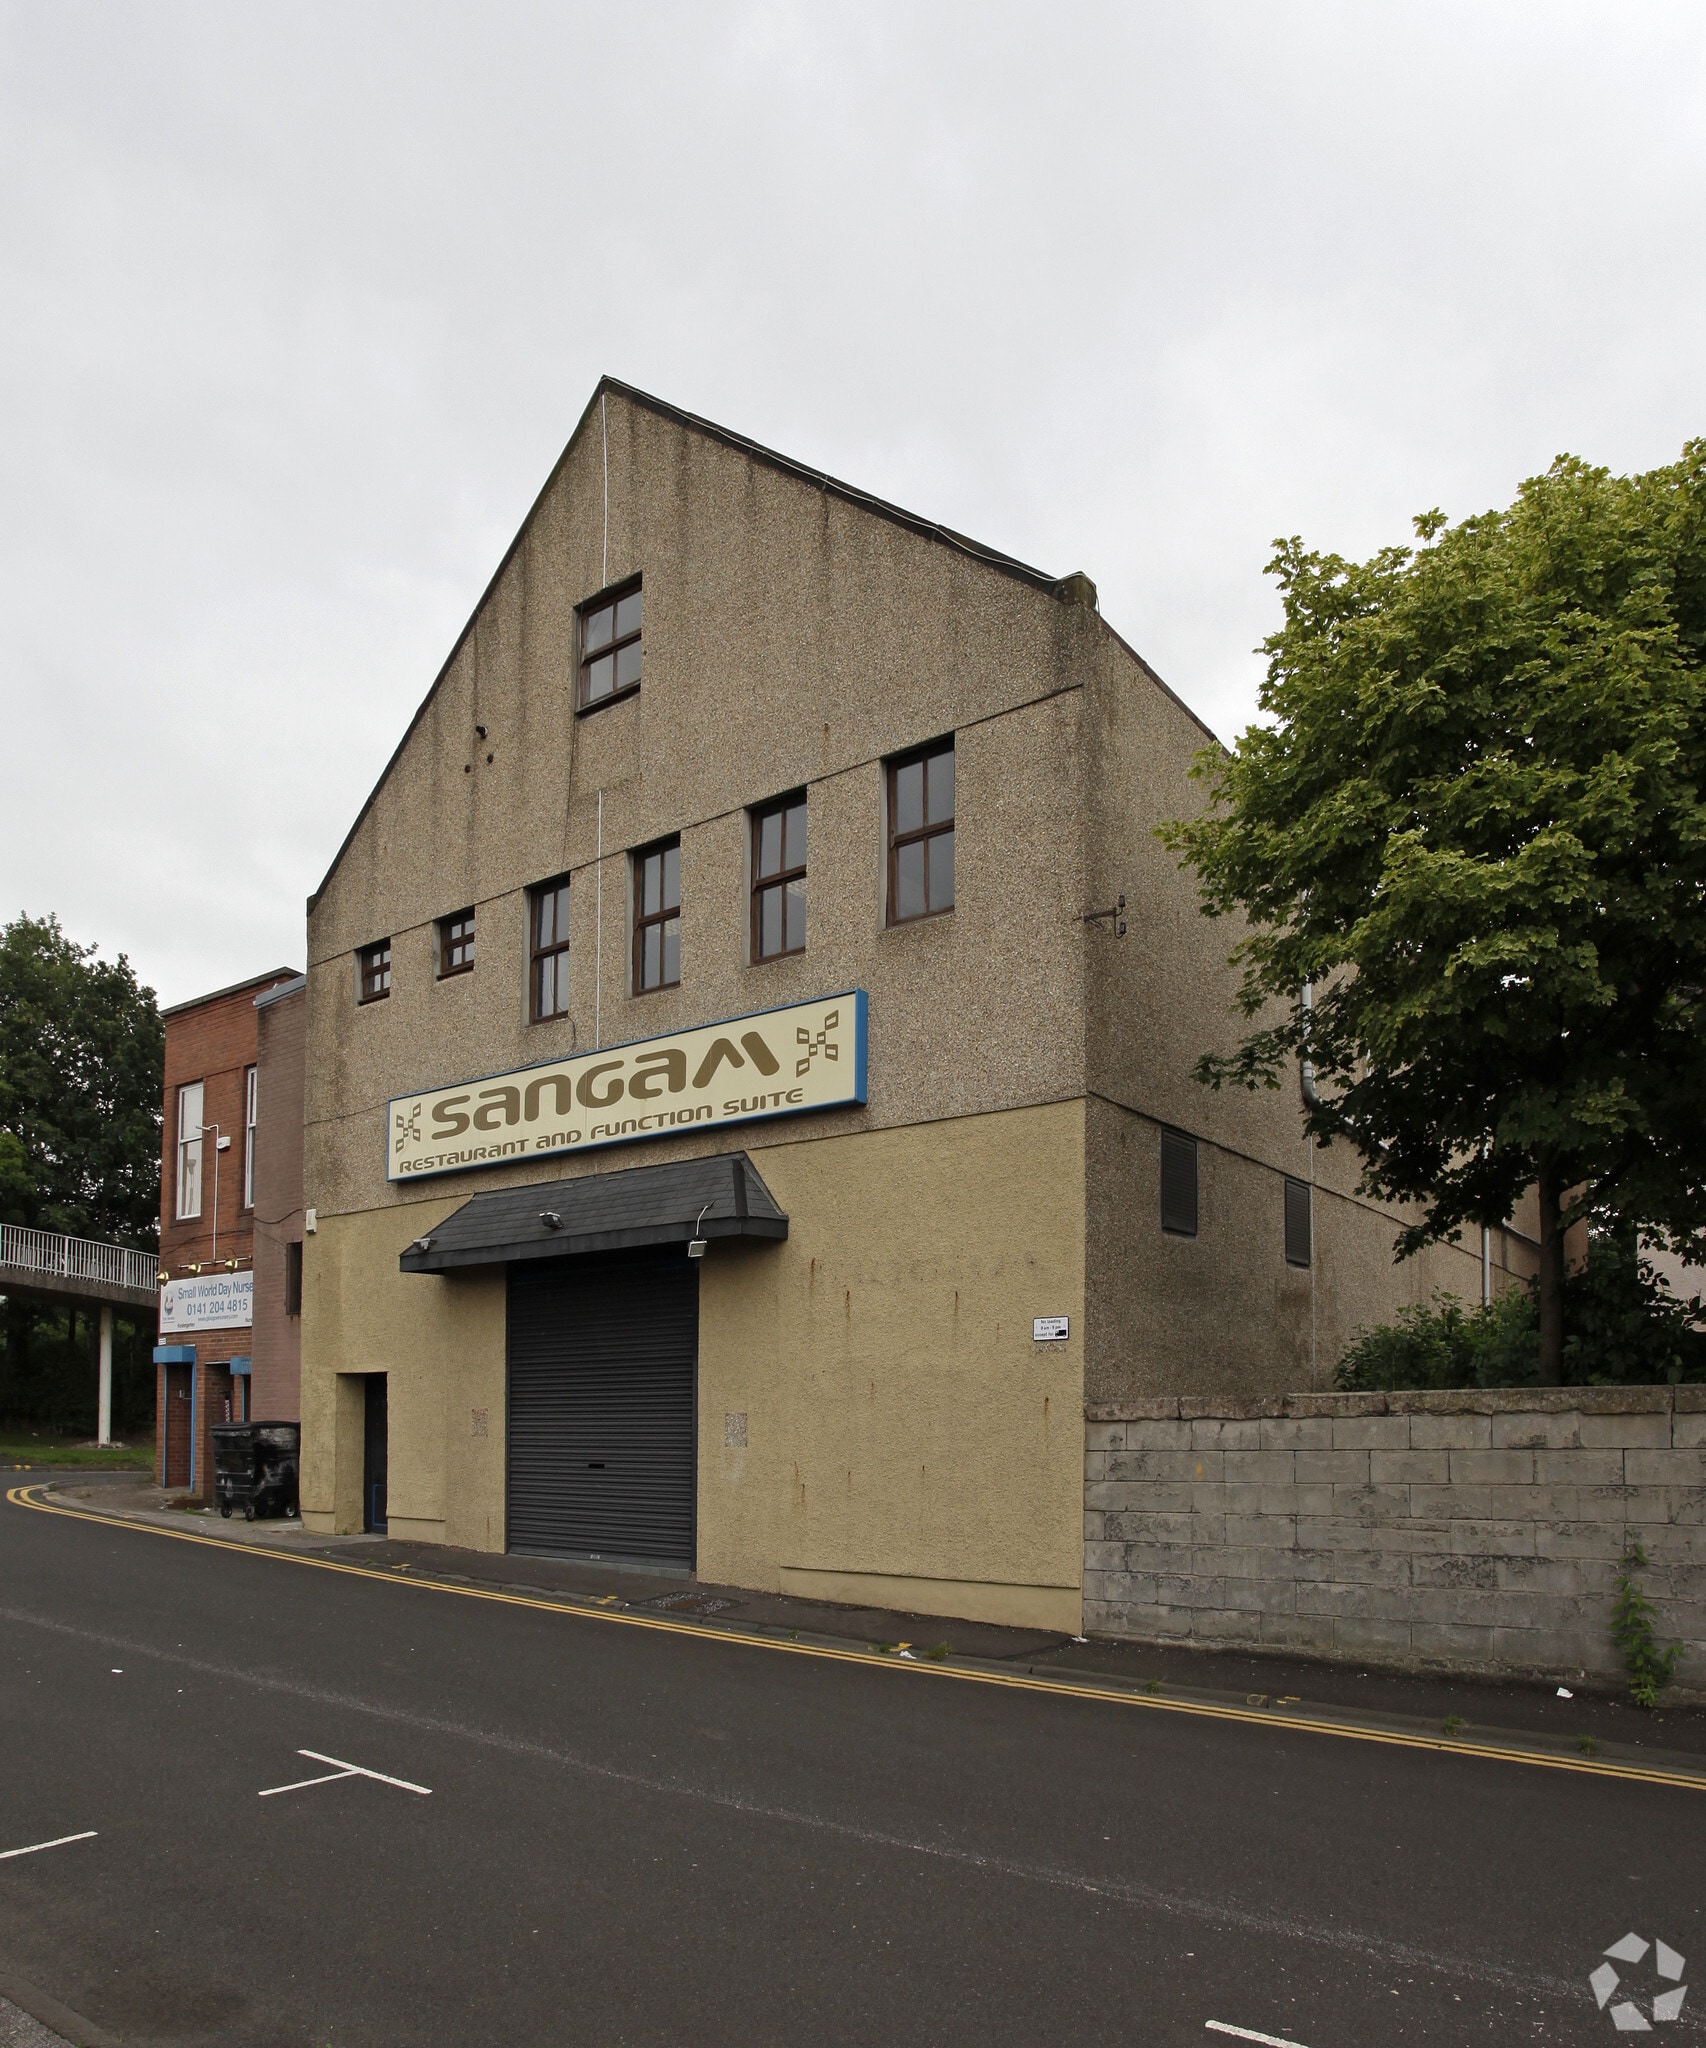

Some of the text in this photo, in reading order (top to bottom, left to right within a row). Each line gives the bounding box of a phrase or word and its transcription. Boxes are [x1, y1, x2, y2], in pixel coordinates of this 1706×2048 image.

[399, 1087, 804, 1173] RESTAURANT AND FUNCTION SUITE
[178, 1286, 196, 1300] Small
[198, 1284, 217, 1298] World
[218, 1283, 232, 1298] Day
[186, 1299, 248, 1316] 0141 204 4815
